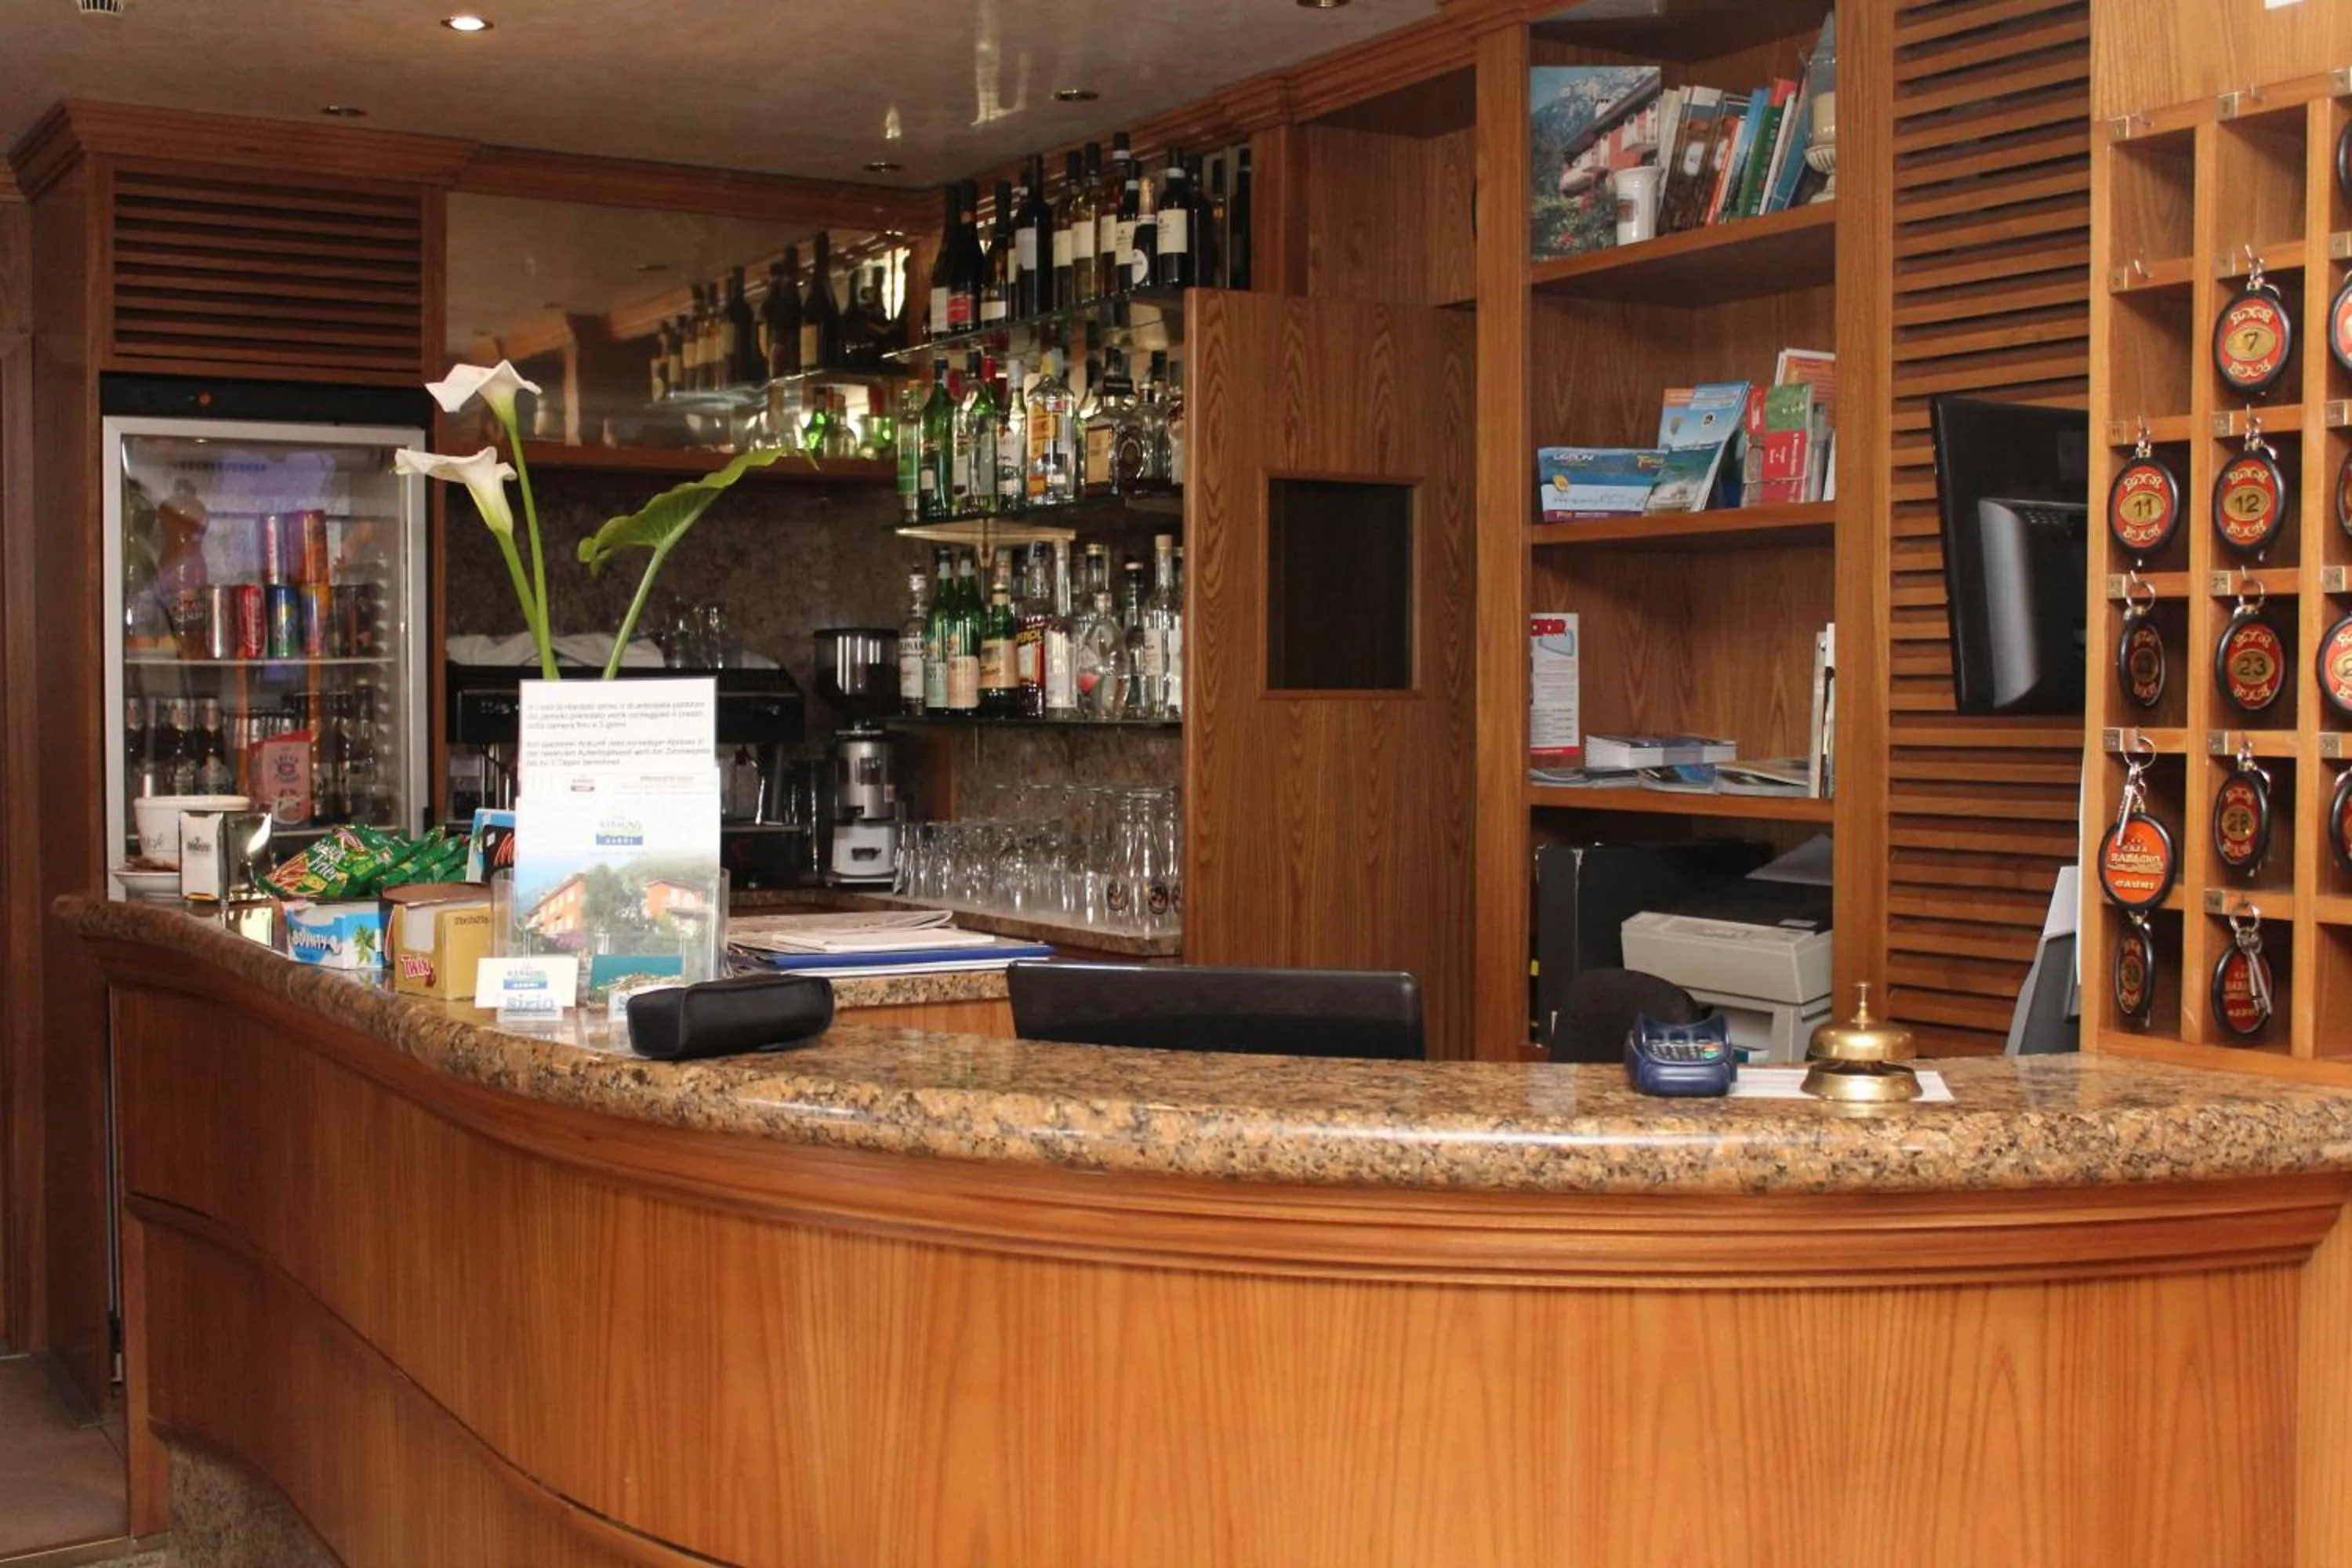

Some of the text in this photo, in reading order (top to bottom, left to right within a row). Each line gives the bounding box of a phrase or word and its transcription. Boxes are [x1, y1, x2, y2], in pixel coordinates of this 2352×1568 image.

[2243, 332, 2259, 352] 7
[2132, 498, 2153, 517] 11
[2234, 493, 2259, 514] 12
[2238, 656, 2267, 677] 23
